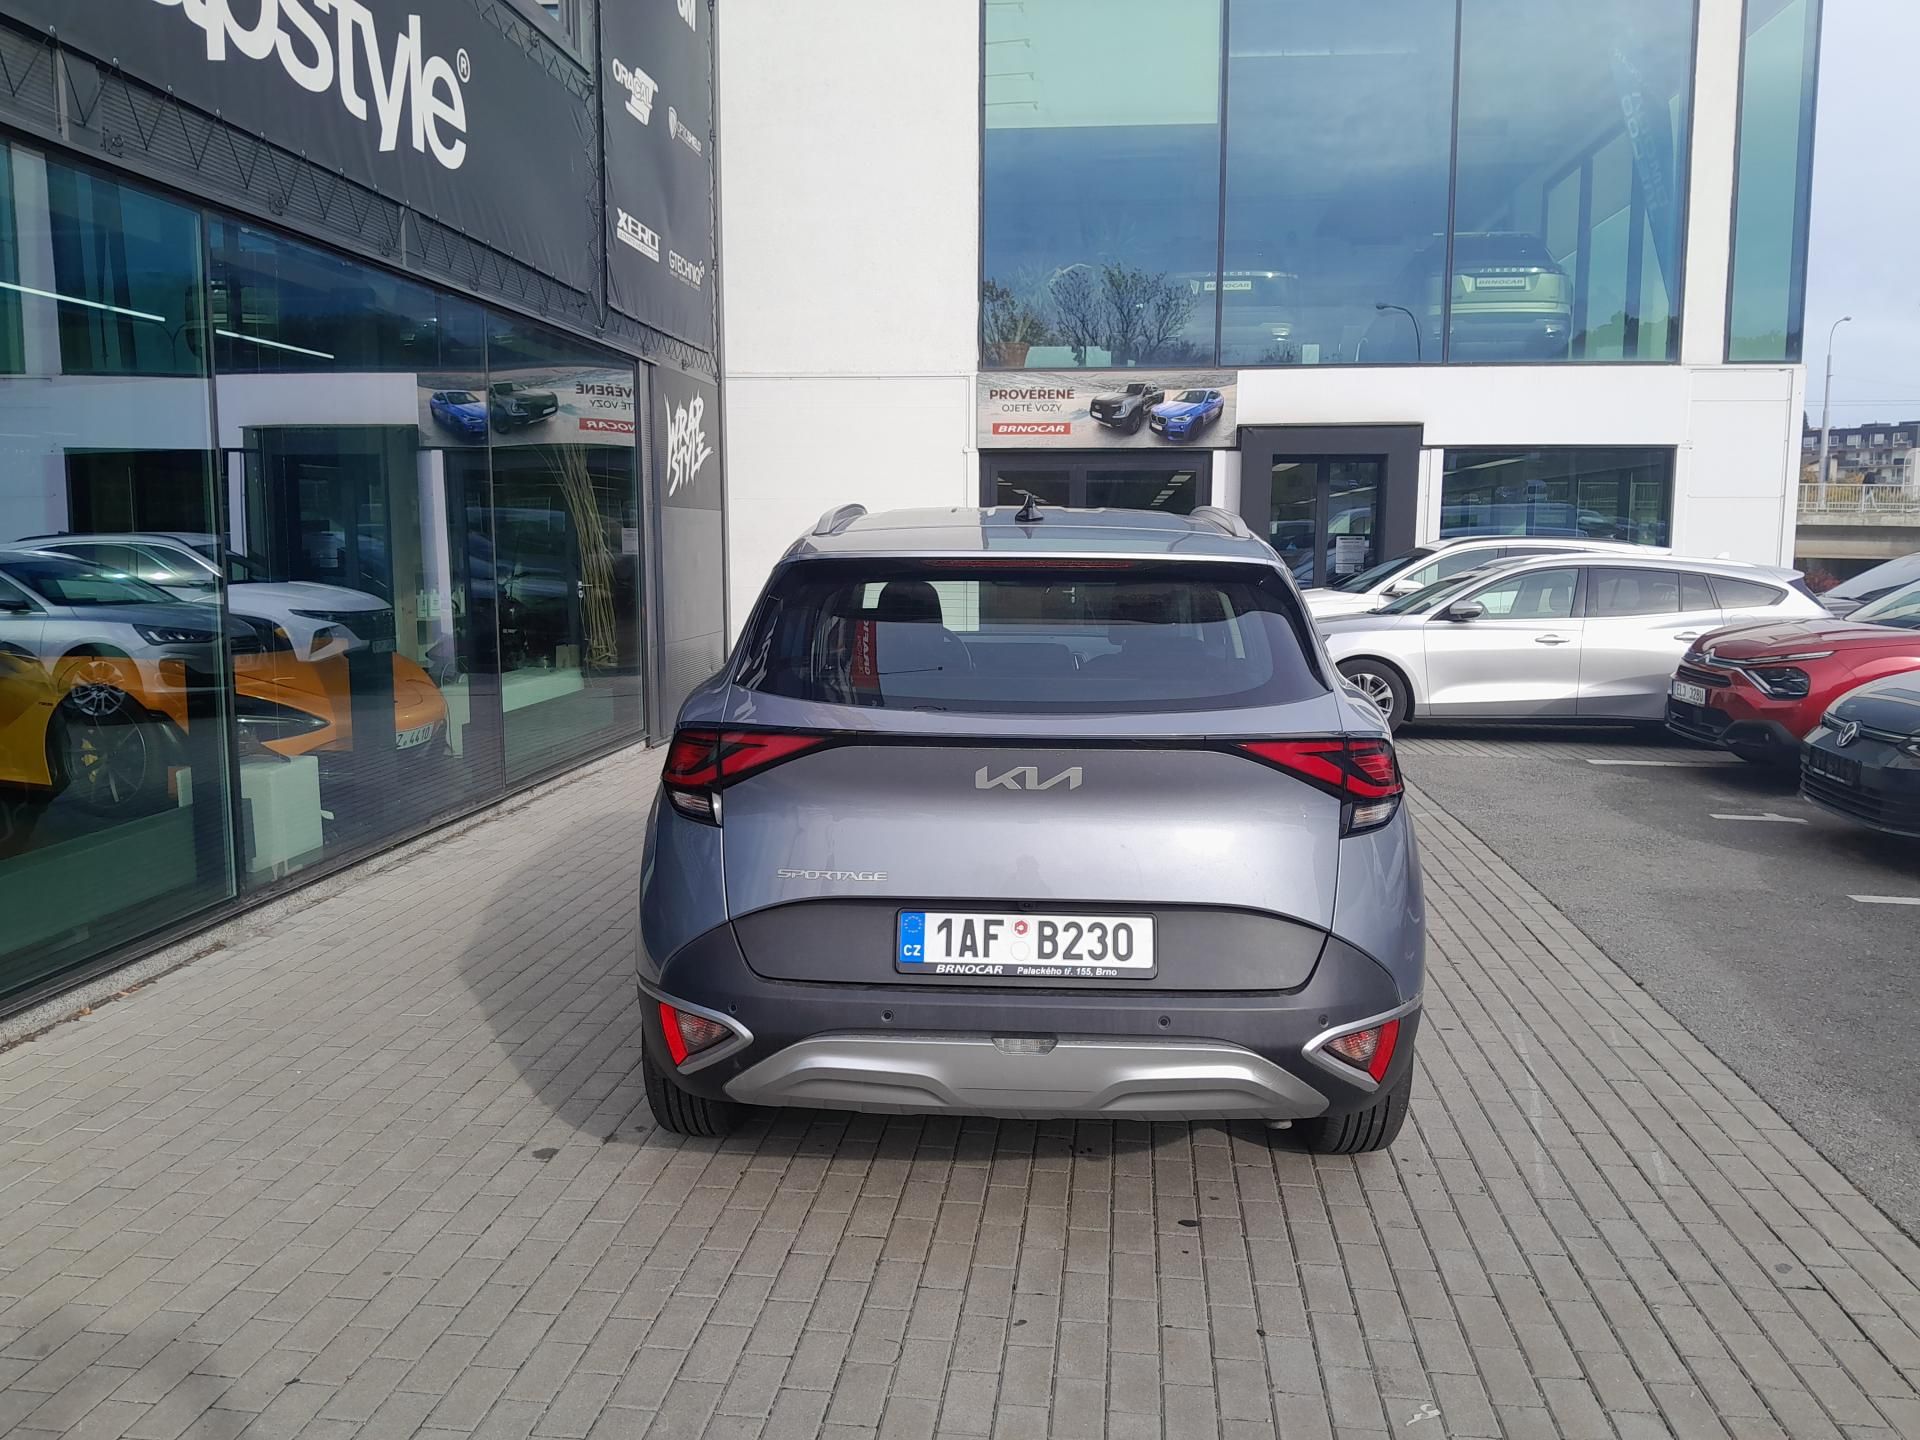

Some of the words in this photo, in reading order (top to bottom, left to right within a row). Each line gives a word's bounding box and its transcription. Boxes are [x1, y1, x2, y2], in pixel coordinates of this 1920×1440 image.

[989, 386, 1075, 400] PROVĚŘENÉ
[1001, 403, 1032, 413] OJETÉ
[1034, 404, 1062, 412] VOZY
[998, 425, 1065, 433] BRNOCAR
[975, 766, 1083, 790] KIA
[777, 869, 888, 881] SPORTAGE
[937, 918, 1004, 958] 1AF
[1037, 920, 1134, 962] B230
[903, 944, 921, 956] CZ
[936, 964, 1003, 974] BRNOCAR
[1017, 966, 1062, 976] Palackého
[1076, 967, 1094, 977] 155,
[1095, 968, 1118, 976] Brno
